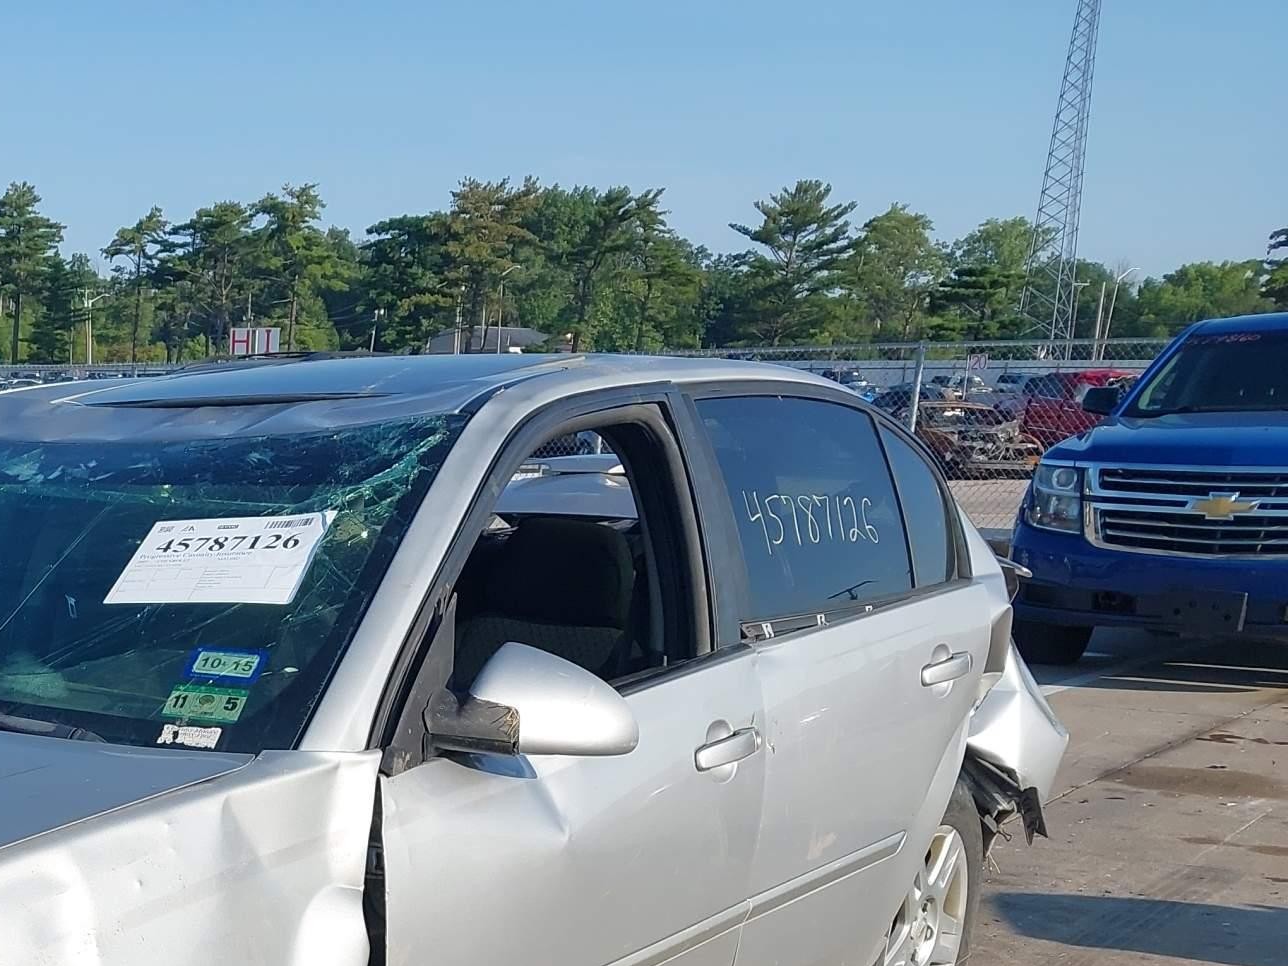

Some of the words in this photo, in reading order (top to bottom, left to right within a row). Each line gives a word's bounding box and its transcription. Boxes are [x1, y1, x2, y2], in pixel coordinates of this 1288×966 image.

[971, 354, 988, 370] 20
[741, 490, 879, 555] 45787126
[155, 531, 305, 553] 45787126
[201, 655, 223, 670] 10
[231, 659, 255, 673] 15
[171, 693, 189, 709] 11
[223, 696, 240, 712] 5
